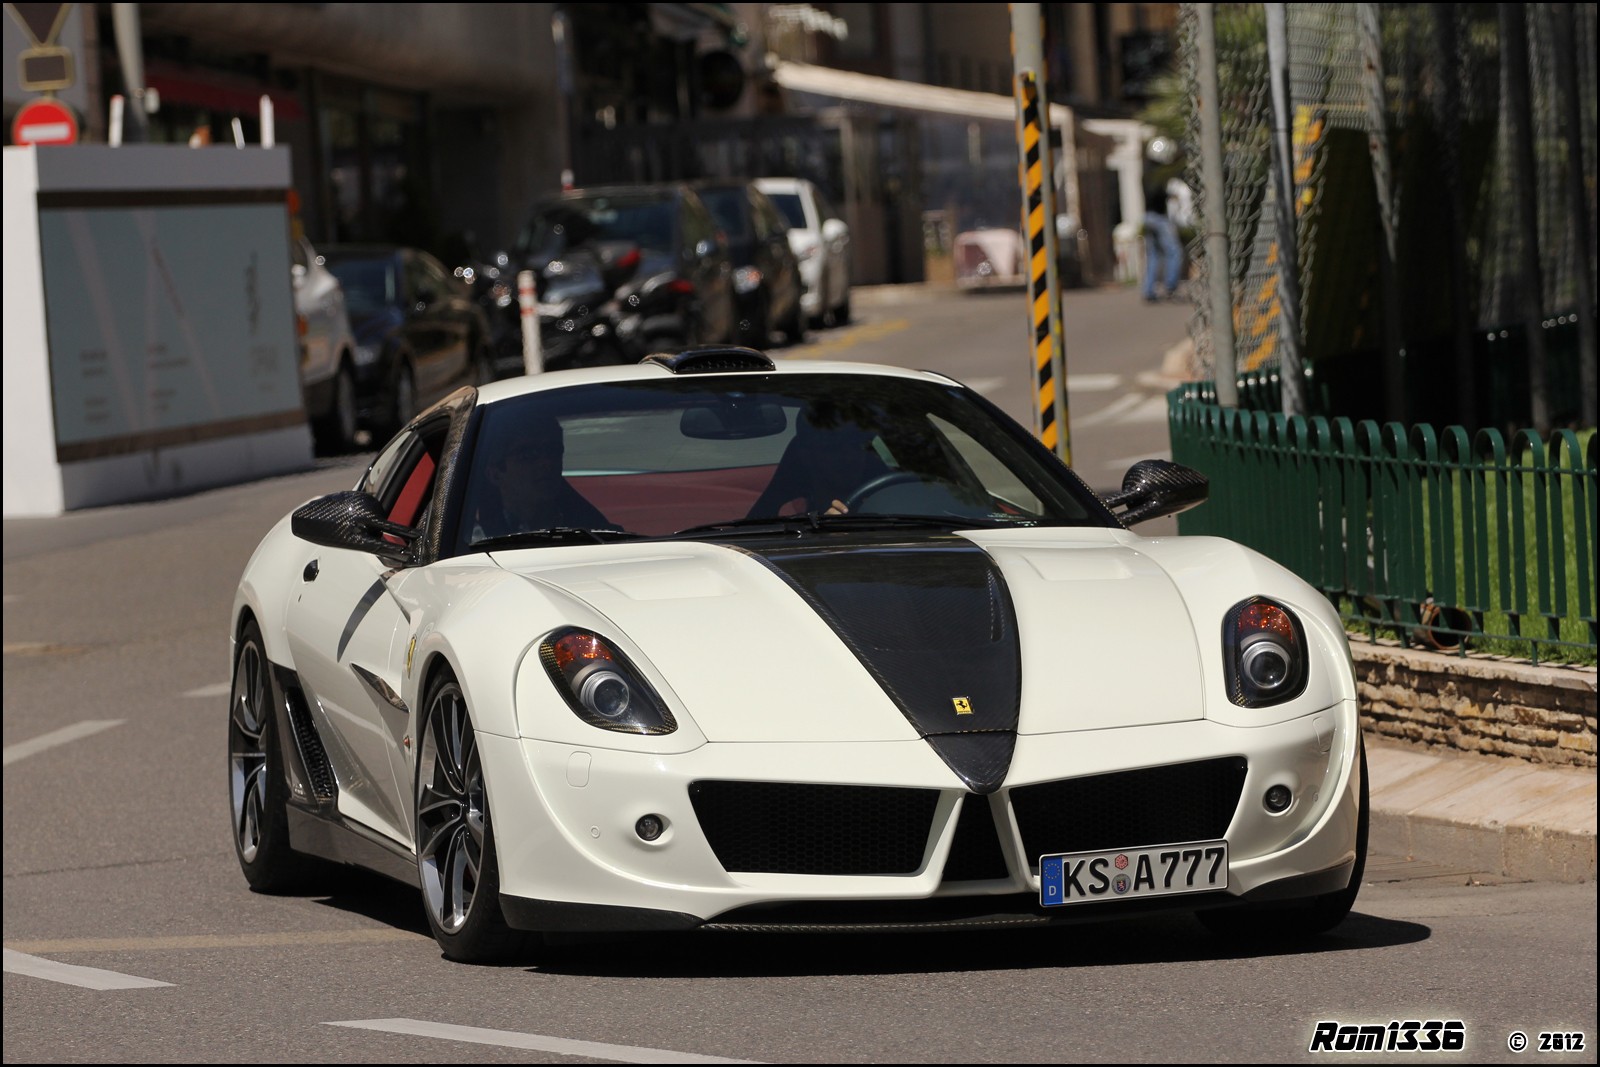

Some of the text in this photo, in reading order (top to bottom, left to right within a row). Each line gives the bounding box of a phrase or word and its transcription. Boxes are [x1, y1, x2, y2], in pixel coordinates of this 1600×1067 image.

[1063, 847, 1226, 898] KS A777
[1049, 886, 1057, 896] D
